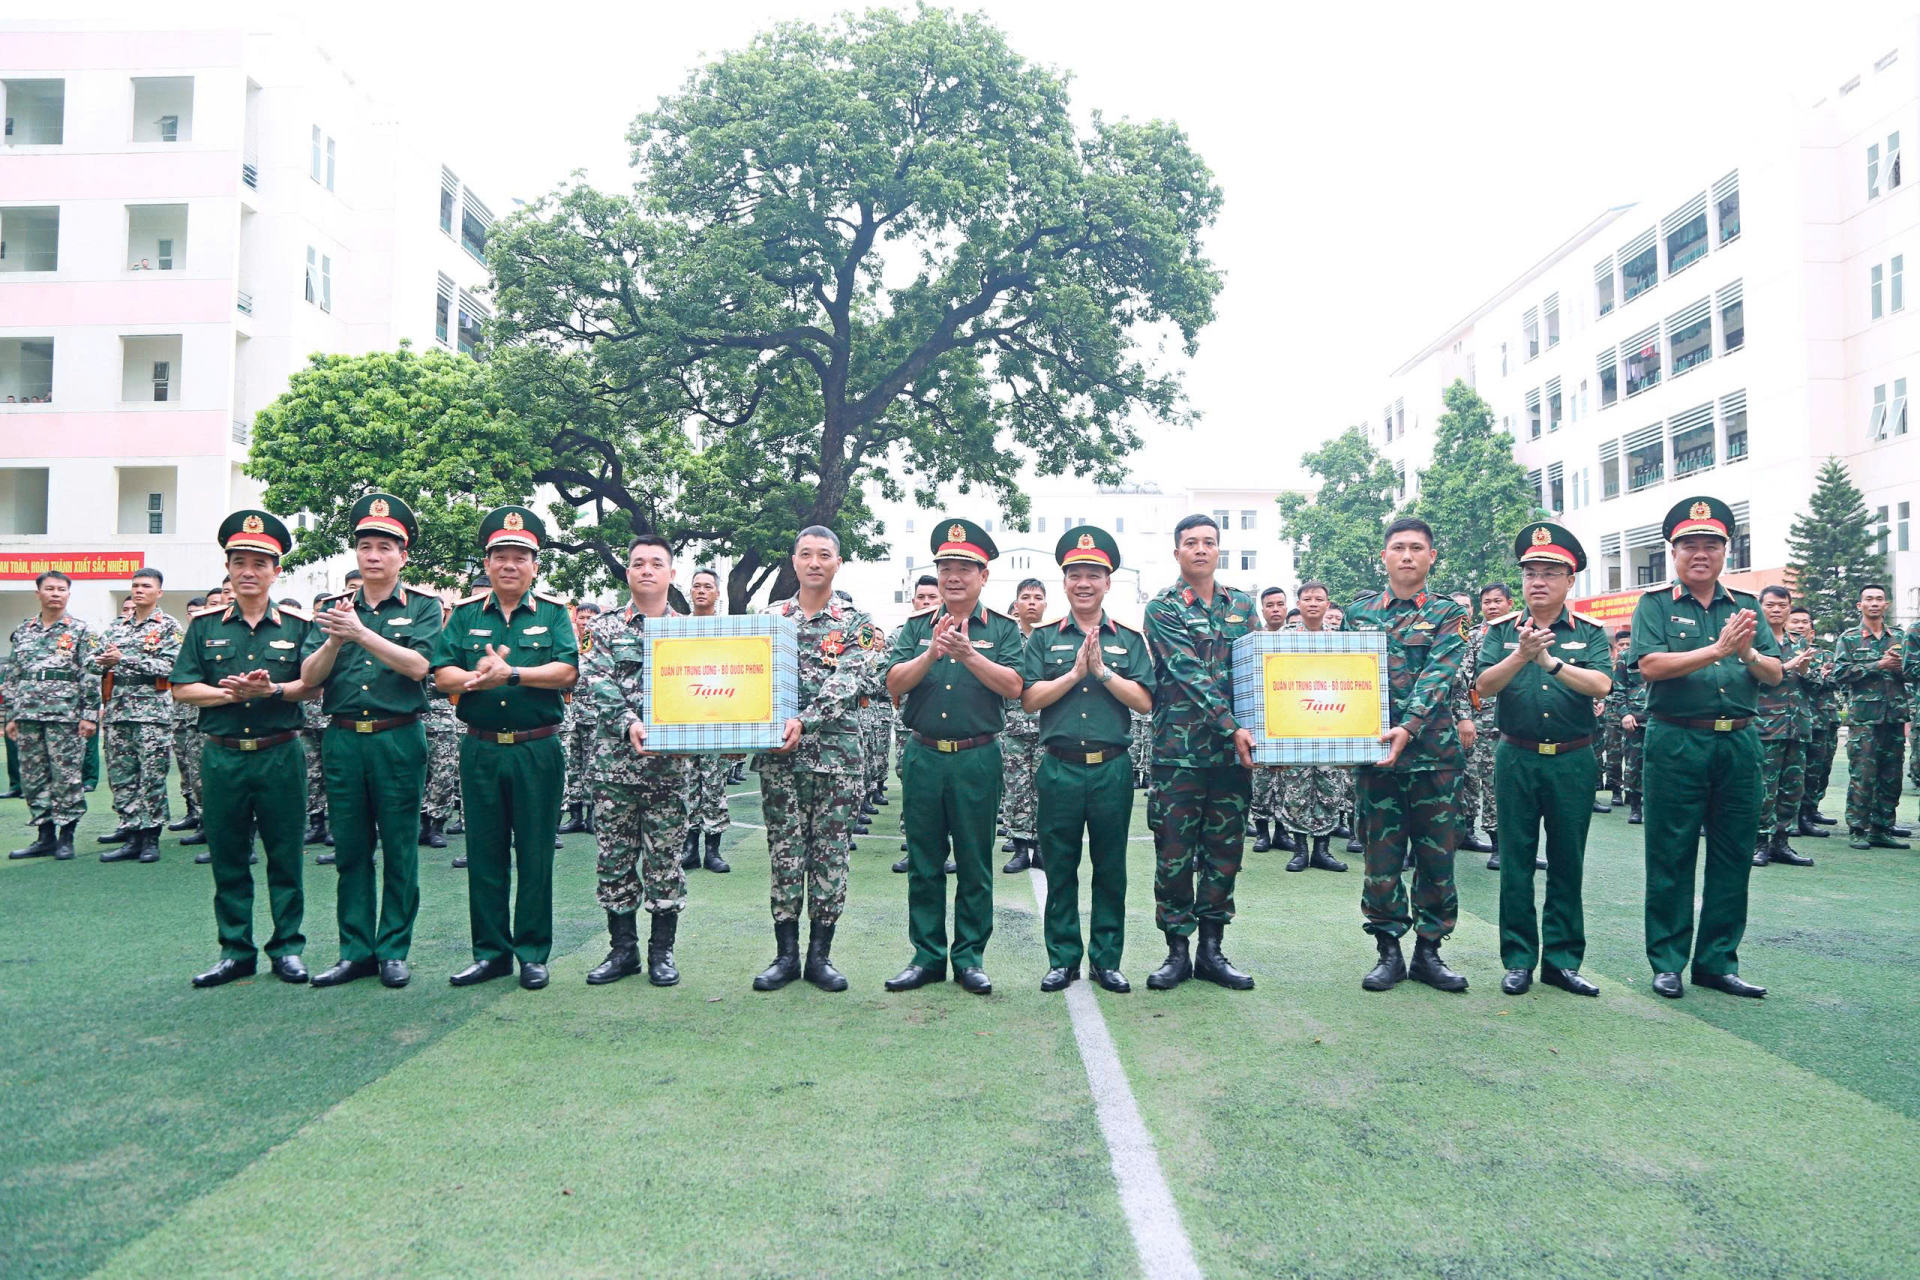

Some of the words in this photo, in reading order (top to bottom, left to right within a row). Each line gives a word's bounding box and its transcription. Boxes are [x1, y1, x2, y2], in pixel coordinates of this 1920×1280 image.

[74, 556, 91, 573] XUẤT
[107, 558, 129, 575] NHIỆM
[684, 665, 701, 676] TRUNG
[702, 664, 717, 675] ƯƠNG
[730, 662, 744, 675] QUỐC
[686, 684, 736, 699] Tặng
[1295, 680, 1312, 690] TRUNG
[1299, 698, 1346, 714] Tặng
